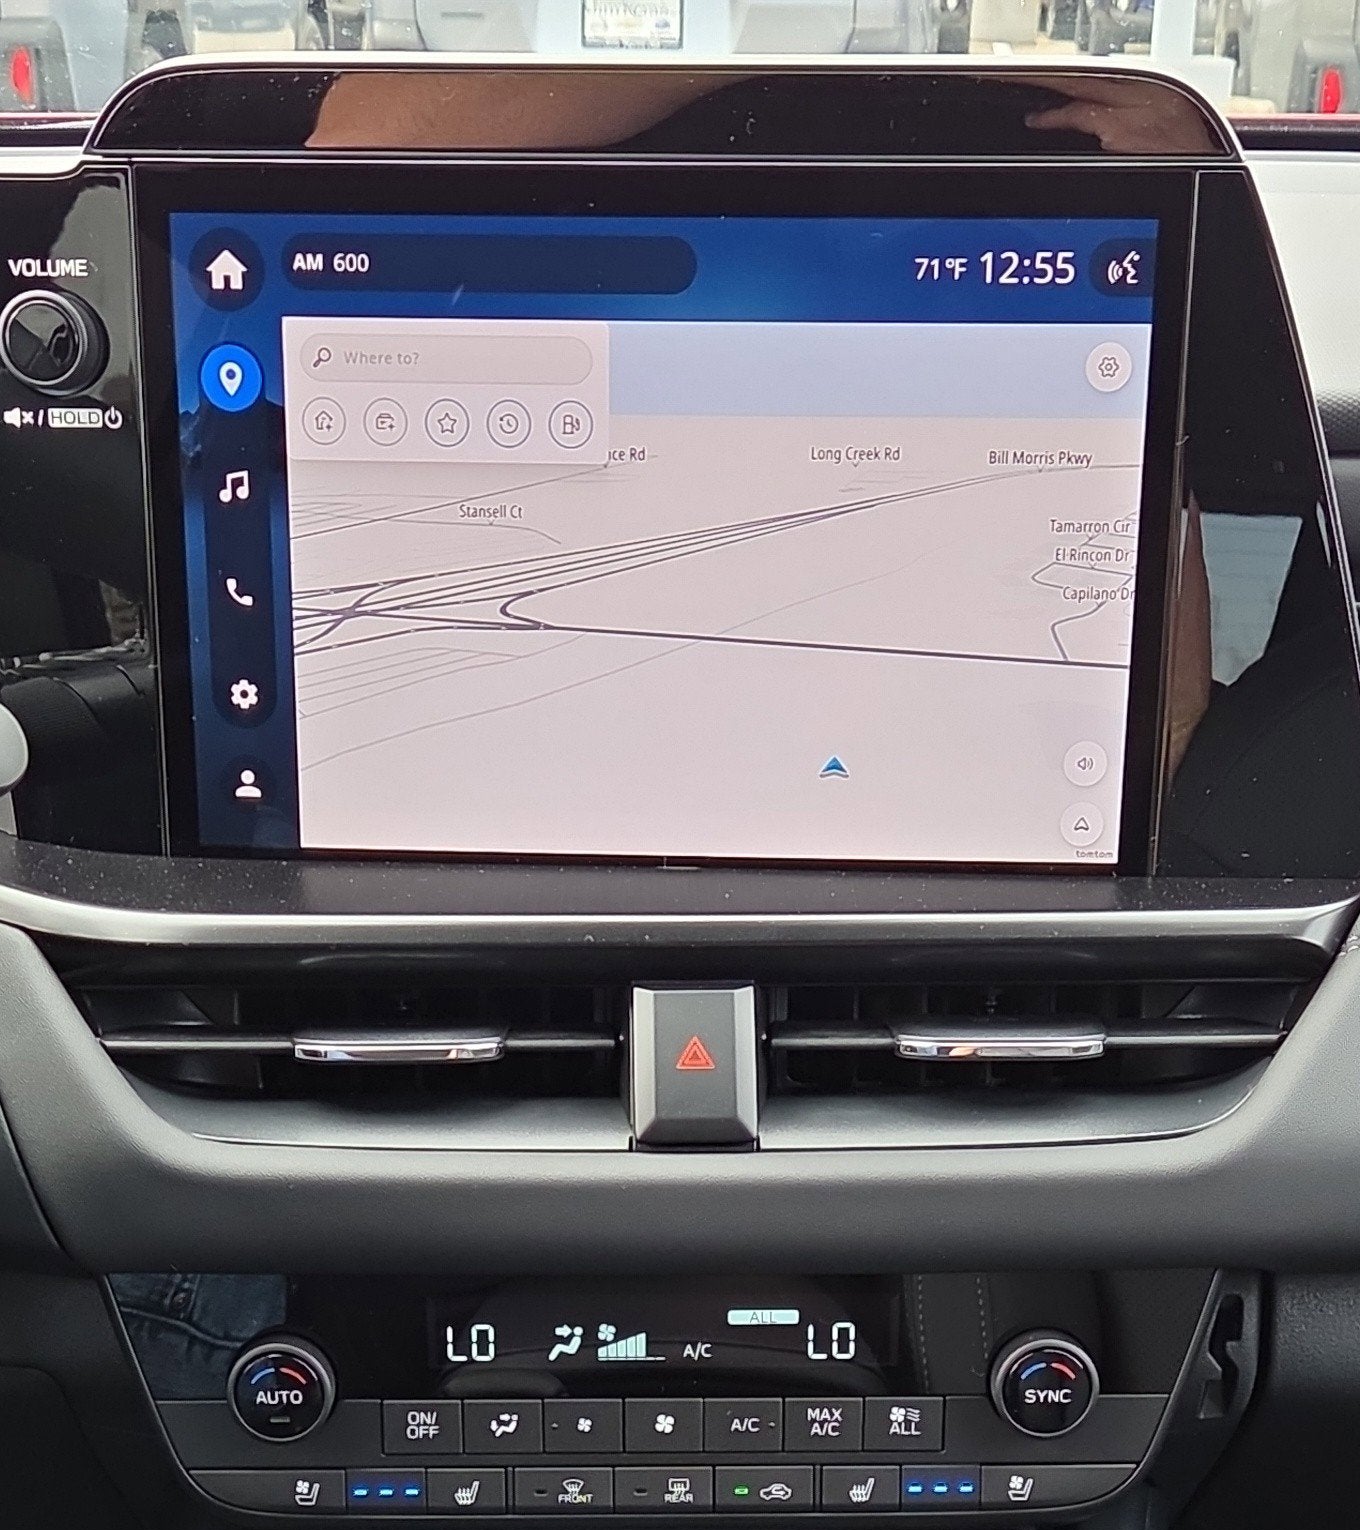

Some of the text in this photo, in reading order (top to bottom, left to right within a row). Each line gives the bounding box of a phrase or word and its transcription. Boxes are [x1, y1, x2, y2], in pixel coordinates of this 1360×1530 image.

[8, 258, 89, 277] VOLUME
[292, 253, 370, 273] AM 600
[914, 251, 1076, 285] 71°F 12:55
[344, 350, 419, 366] Where to?
[49, 409, 101, 426] HOLD
[629, 447, 645, 462] Rd
[810, 446, 901, 464] Long Creek Rd
[988, 450, 1093, 469] Bill Morris Pkwy
[459, 505, 523, 520] Stansell Ct
[1050, 519, 1131, 534] Tamarron Cir
[1055, 548, 1130, 563] El Rincon Dr
[1063, 586, 1135, 604] Capilano Dr
[1075, 850, 1114, 858] tomtom
[749, 1311, 777, 1324] ALL
[446, 1324, 496, 1363] LO
[807, 1322, 856, 1360] LO
[683, 1343, 713, 1360] A/C
[255, 1390, 303, 1405] AUTO
[1024, 1388, 1072, 1405] SYNC
[407, 1411, 437, 1426] ON/
[807, 1408, 843, 1422] MAX
[406, 1425, 440, 1440] OFF
[730, 1417, 761, 1433] A/C
[810, 1422, 841, 1437] A/C
[889, 1421, 922, 1436] ALL
[558, 1494, 594, 1505] FRONT
[664, 1493, 694, 1504] REAR
